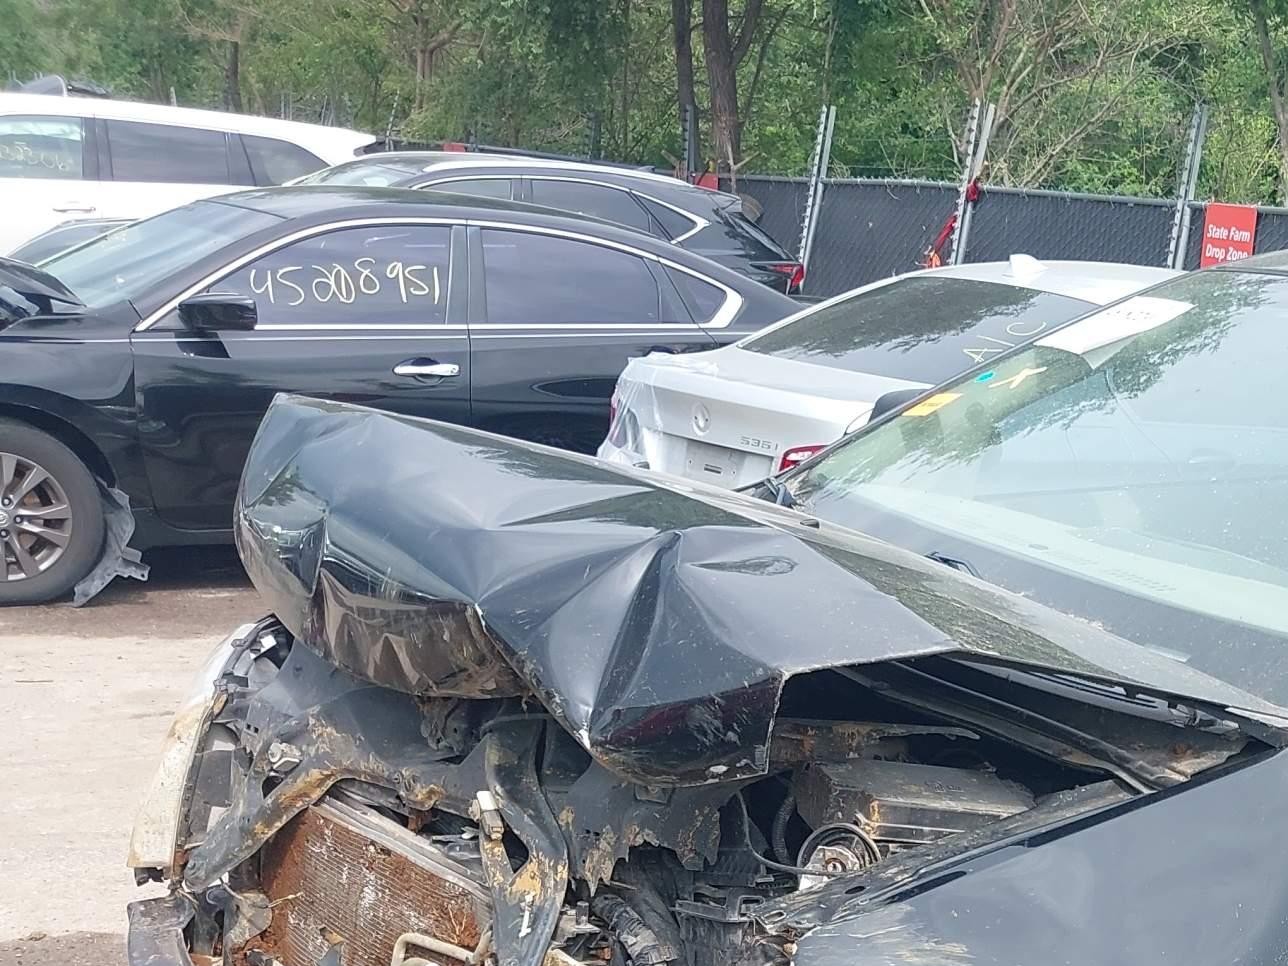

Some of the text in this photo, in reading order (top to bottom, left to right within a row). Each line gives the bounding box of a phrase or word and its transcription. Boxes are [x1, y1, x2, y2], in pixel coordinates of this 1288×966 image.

[1207, 224, 1251, 242] State Farm
[1205, 244, 1225, 262] Drop
